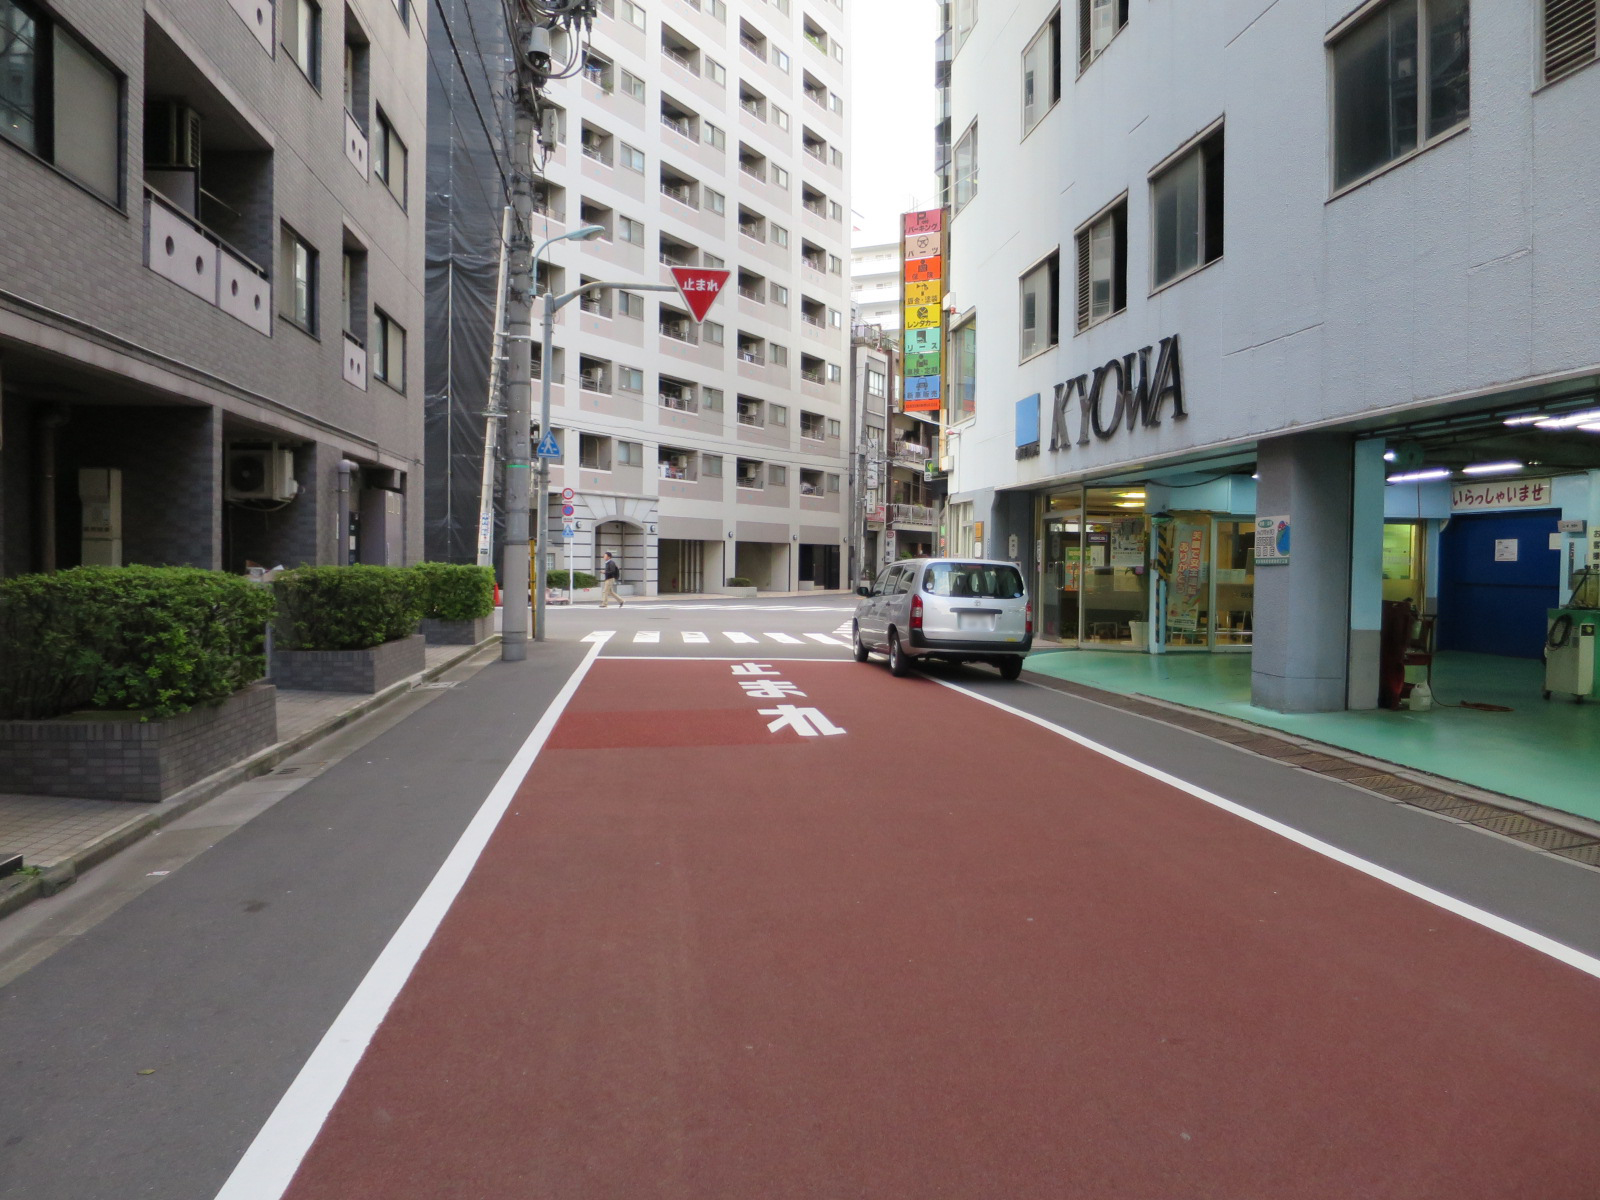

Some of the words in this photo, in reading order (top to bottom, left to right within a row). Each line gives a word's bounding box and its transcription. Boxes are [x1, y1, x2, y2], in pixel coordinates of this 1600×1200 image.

[907, 223, 938, 233] パーキング
[682, 277, 719, 292] 止まれ
[907, 319, 938, 329] レンタカー
[907, 342, 938, 352] リース
[1048, 333, 1189, 452] KYOWA
[1453, 483, 1544, 506] いらっしゃいませ
[730, 662, 847, 736] 止まれ
